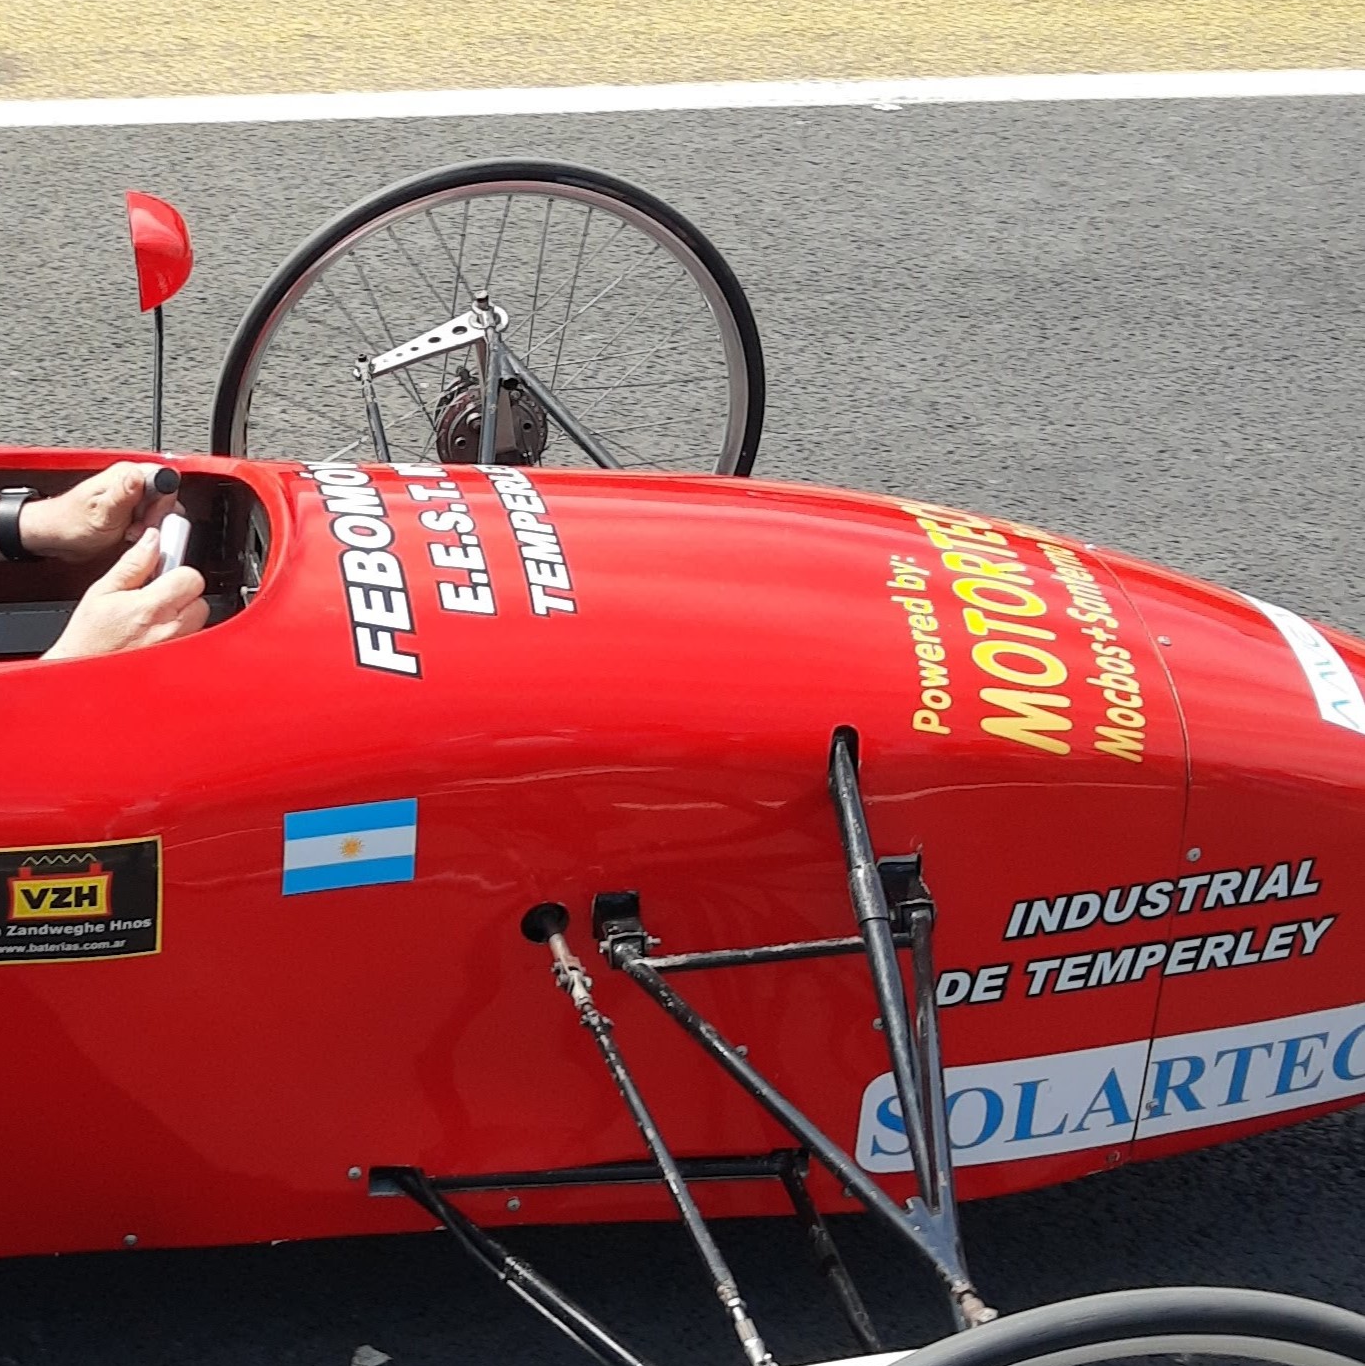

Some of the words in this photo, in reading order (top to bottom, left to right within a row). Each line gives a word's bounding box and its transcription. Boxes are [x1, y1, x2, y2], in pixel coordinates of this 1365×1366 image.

[886, 555, 931, 592] by:
[890, 595, 952, 735] Powered
[21, 885, 98, 909] VZH
[1005, 859, 1320, 939] INDUSTRIAL
[6, 921, 105, 937] Zandweghe
[110, 918, 152, 931] Hnos
[936, 966, 1009, 1006] DE
[1026, 917, 1335, 996] TEMPERLEY
